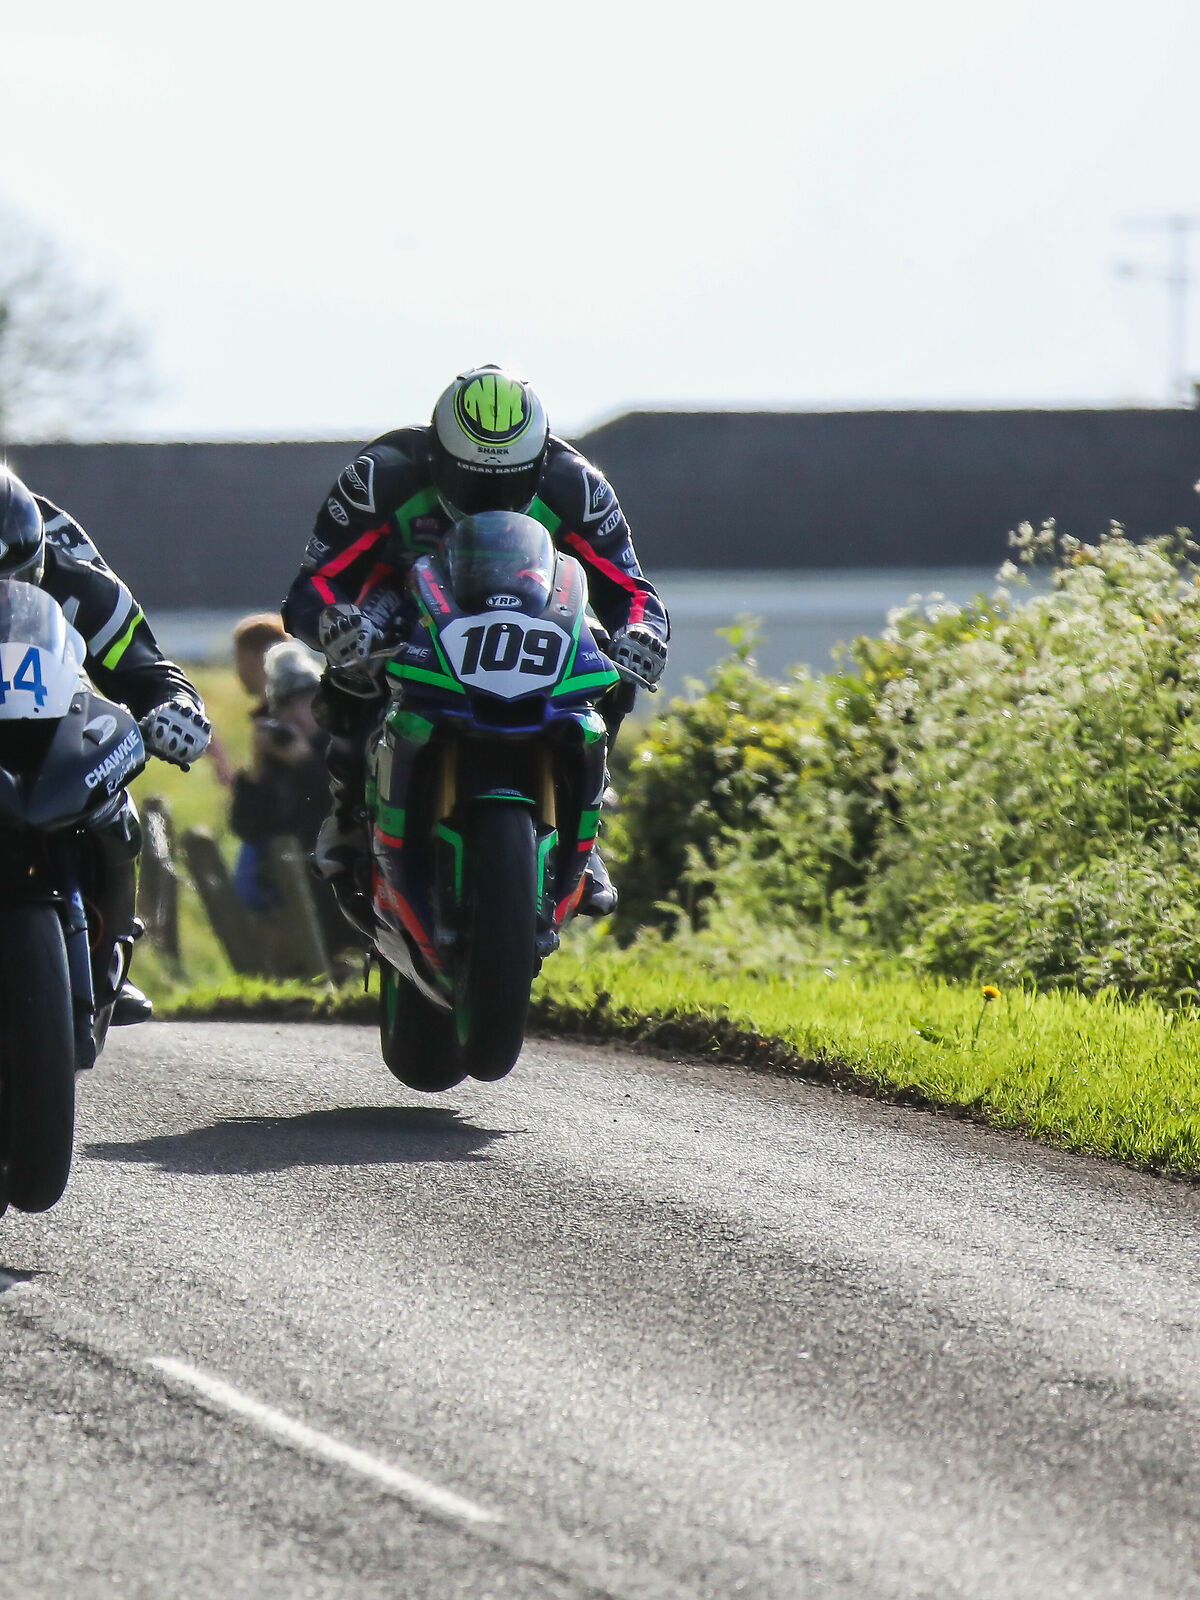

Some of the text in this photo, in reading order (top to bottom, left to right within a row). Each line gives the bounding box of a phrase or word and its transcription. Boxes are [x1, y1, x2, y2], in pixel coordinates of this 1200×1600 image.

[477, 447, 509, 455] SHARK
[599, 510, 619, 534] YRP
[491, 597, 517, 606] YRP
[460, 623, 562, 676] 109
[84, 729, 140, 789] CHAWKIE
